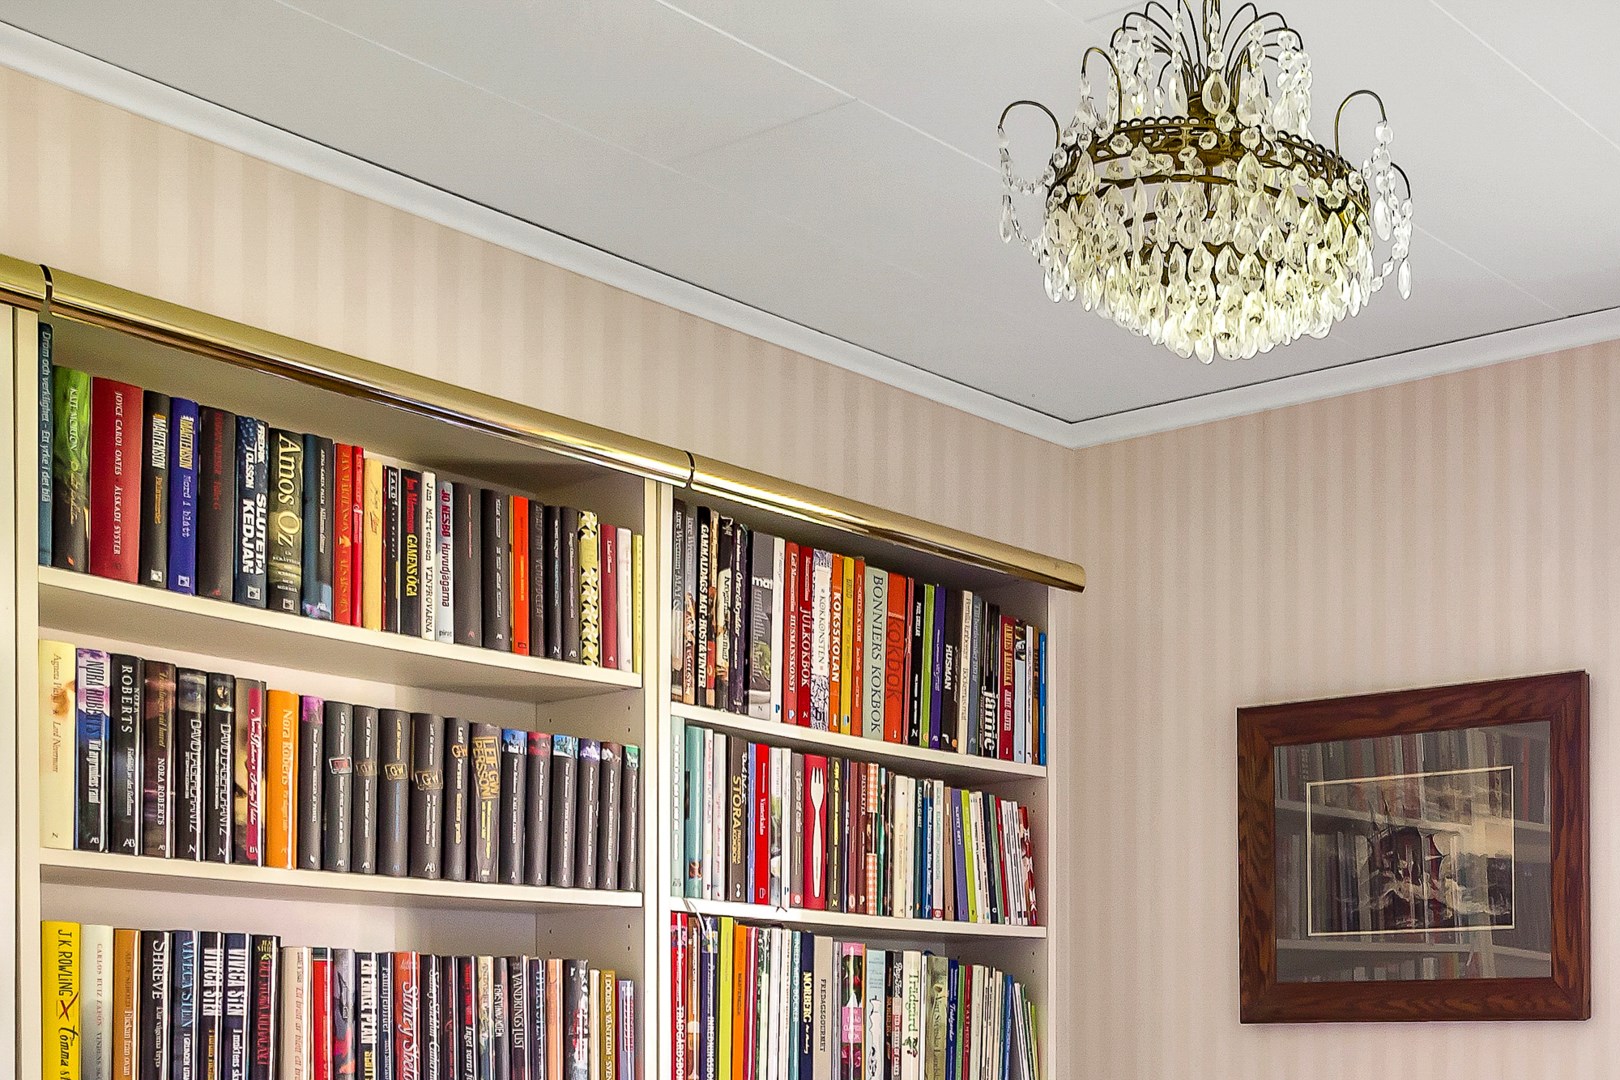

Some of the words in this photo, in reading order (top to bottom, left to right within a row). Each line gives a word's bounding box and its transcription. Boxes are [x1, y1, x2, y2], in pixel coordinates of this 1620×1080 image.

[113, 391, 124, 417] JOYCE
[114, 450, 123, 476] OATES
[256, 424, 266, 464] FREDRIK
[42, 471, 51, 485] det
[278, 433, 301, 505] Amos
[425, 482, 434, 502] Jan
[113, 526, 123, 556] SYSTER
[242, 499, 255, 575] KEDJAN
[254, 493, 267, 561] SLUTET
[278, 510, 301, 547] Oz
[699, 524, 708, 593] GAMMALDAGS
[699, 594, 707, 615] MAT
[871, 575, 884, 660] BONNIERS
[800, 606, 811, 687] JULKOKBOK
[944, 644, 953, 690] HUSMAN
[121, 665, 133, 733] ROBERTS
[871, 665, 882, 733] KOKBOK
[981, 685, 999, 751] jamie
[281, 709, 293, 739] Nora
[157, 758, 165, 783] NORA
[157, 785, 165, 825] ROBERTS
[732, 775, 742, 829] STORA
[58, 951, 74, 997] ROWLING
[151, 940, 166, 1000] SHREVE
[227, 948, 246, 987] VIVECA
[226, 990, 245, 1016] STEN
[512, 972, 524, 1027] VANDRINGS
[511, 1028, 524, 1050] LUST
